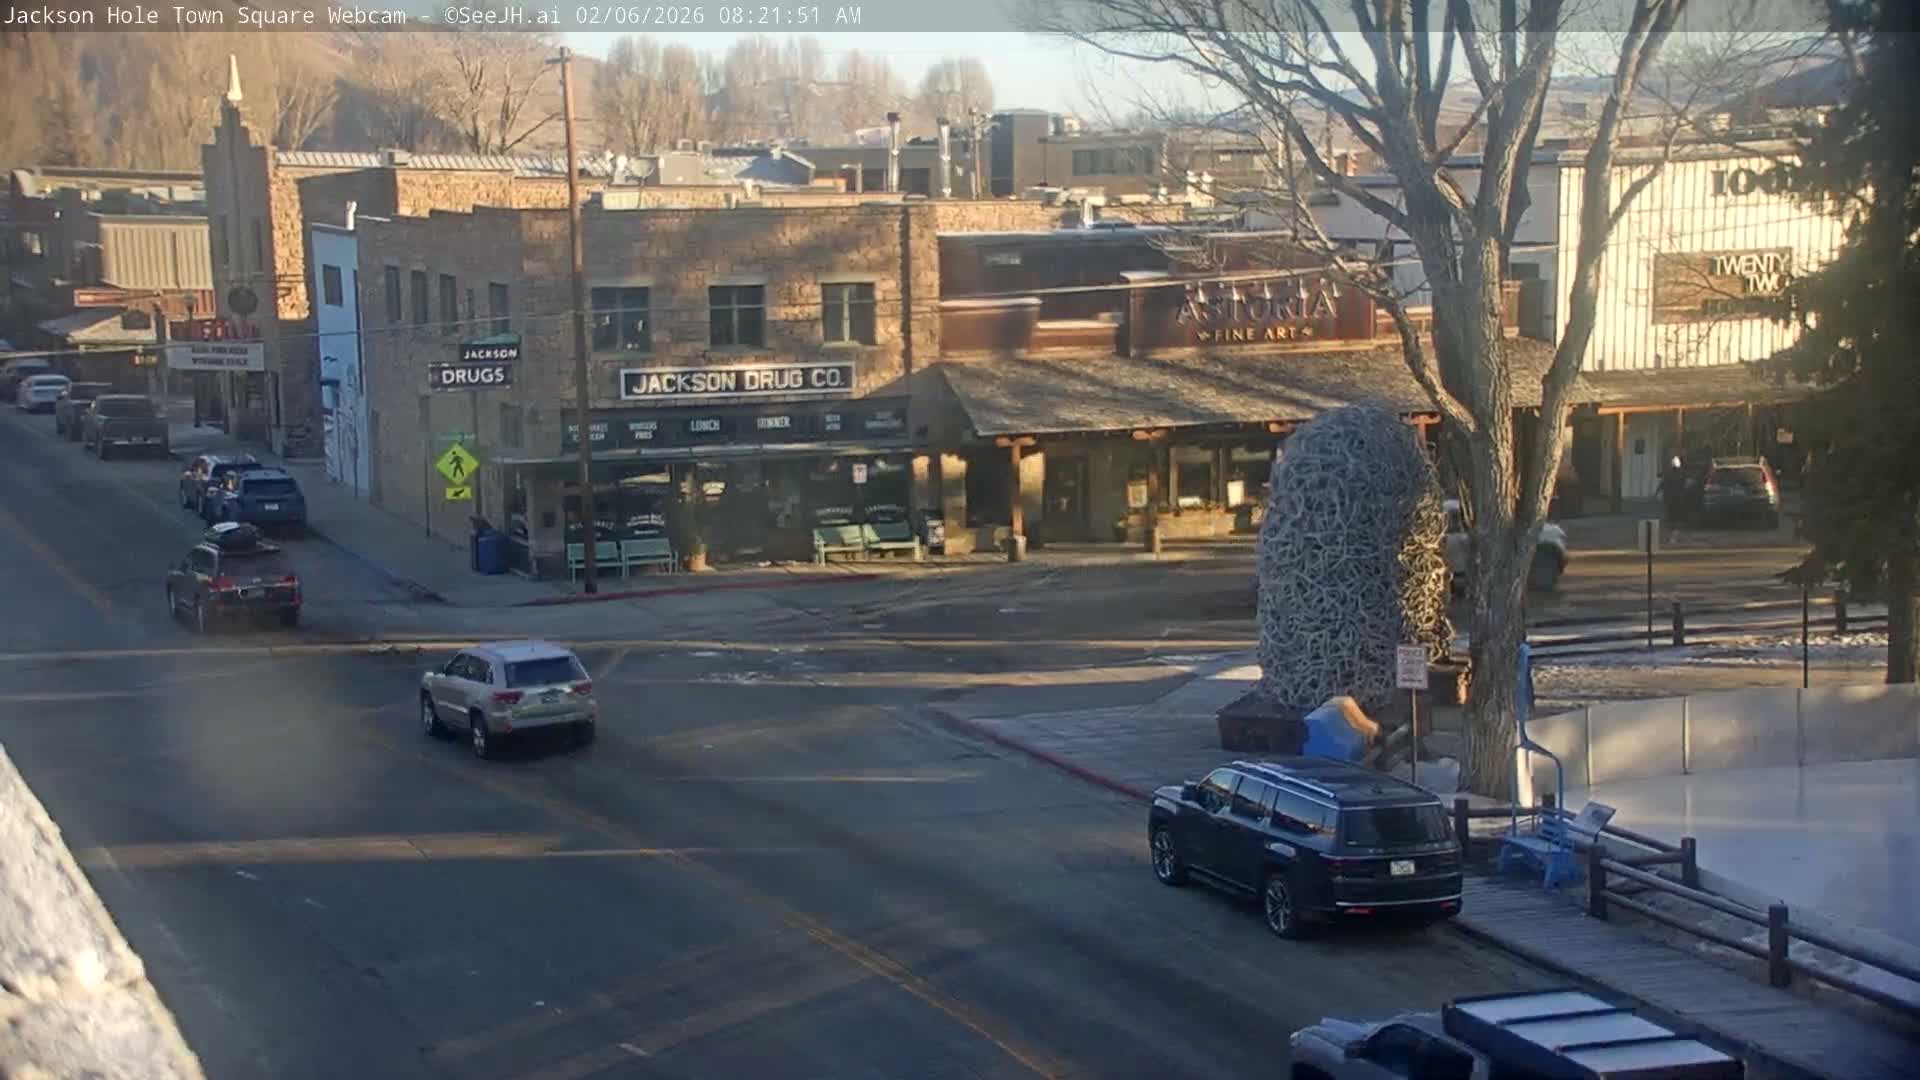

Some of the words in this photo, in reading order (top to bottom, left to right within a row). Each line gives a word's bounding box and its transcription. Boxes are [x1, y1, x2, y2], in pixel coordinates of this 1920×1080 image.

[1715, 253, 1790, 276] TWENTY
[1176, 288, 1338, 325] ASTORIA
[1215, 327, 1256, 342] FINE
[1264, 326, 1297, 341] ART
[463, 348, 518, 360] JACKSON
[441, 367, 505, 385] DRUGS
[632, 371, 736, 395] JACKSON
[743, 369, 804, 391] DRUG
[690, 419, 721, 432] LUNCH
